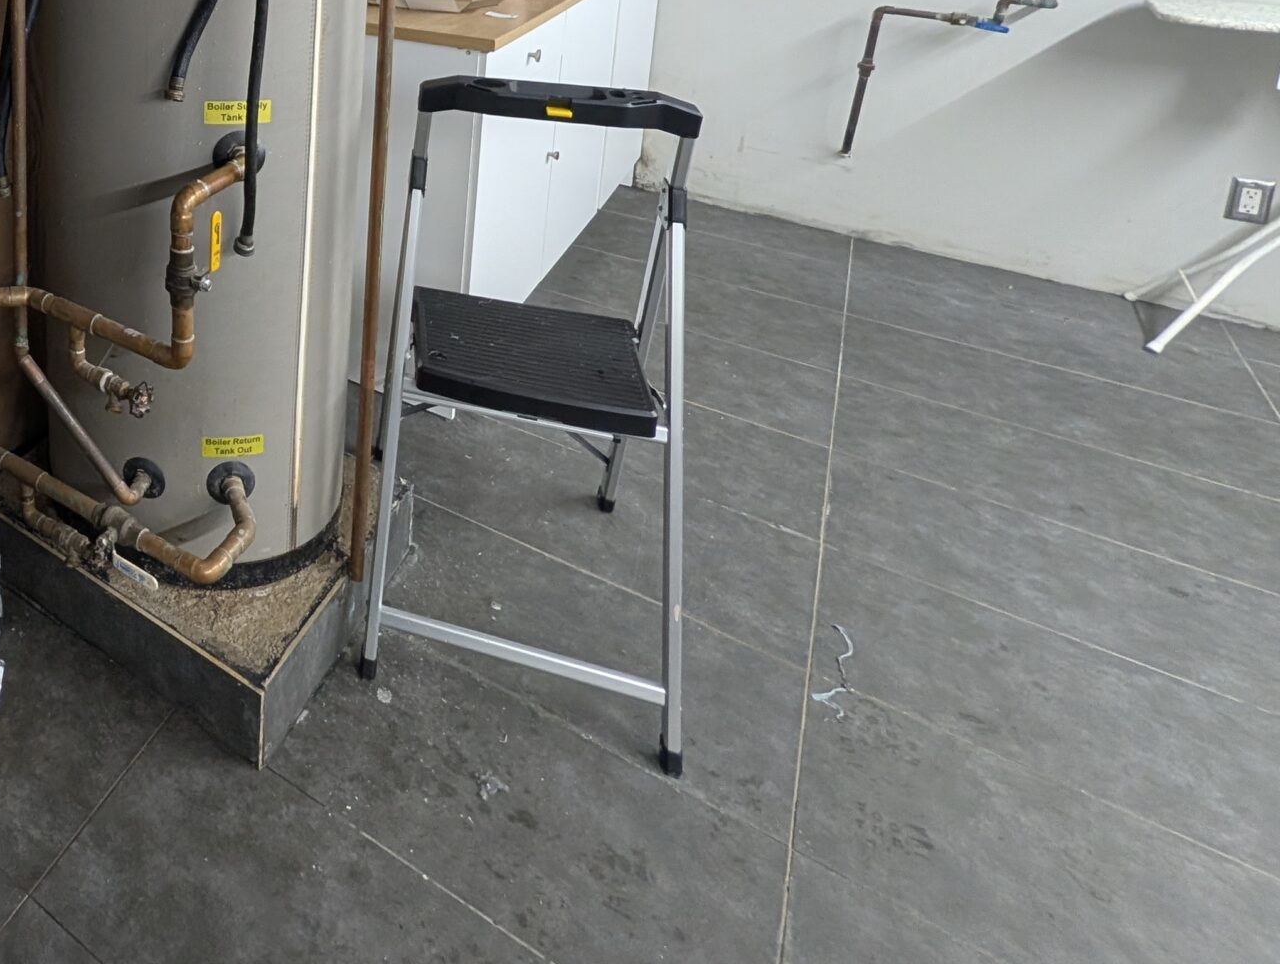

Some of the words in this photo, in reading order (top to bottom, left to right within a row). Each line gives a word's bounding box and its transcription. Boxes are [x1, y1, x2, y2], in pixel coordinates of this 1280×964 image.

[207, 102, 234, 110] Boiler
[220, 113, 243, 121] Tank
[205, 438, 231, 446] Boiler
[233, 436, 261, 445] Return
[214, 447, 235, 455] Tank
[237, 446, 253, 454] Out
